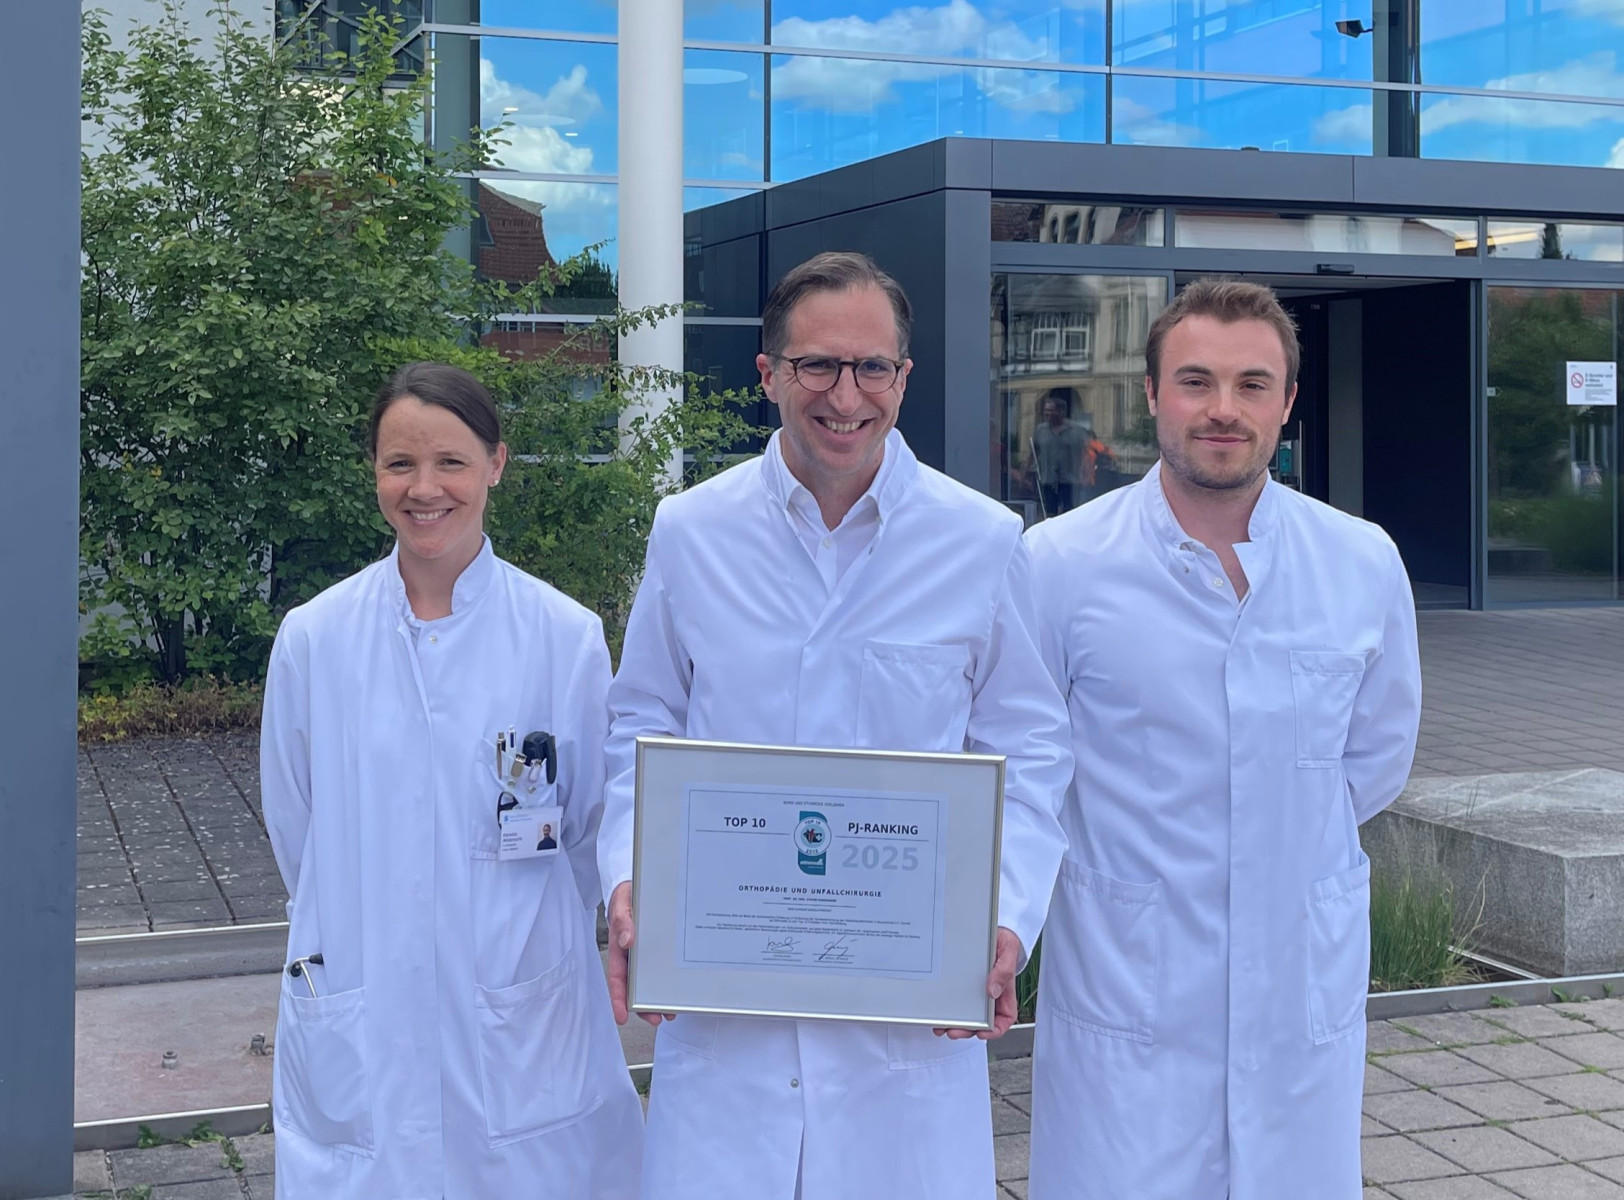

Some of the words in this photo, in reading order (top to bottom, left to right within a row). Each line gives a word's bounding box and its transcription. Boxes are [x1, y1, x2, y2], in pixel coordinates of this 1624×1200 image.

[724, 816, 748, 827] TOP
[752, 817, 766, 828] 10
[848, 822, 919, 835] PJ-RANKING
[842, 843, 919, 871] 2025
[738, 884, 788, 893] ORTHOPÄDIE
[811, 888, 882, 898] UNFALLCHIRURGIE
